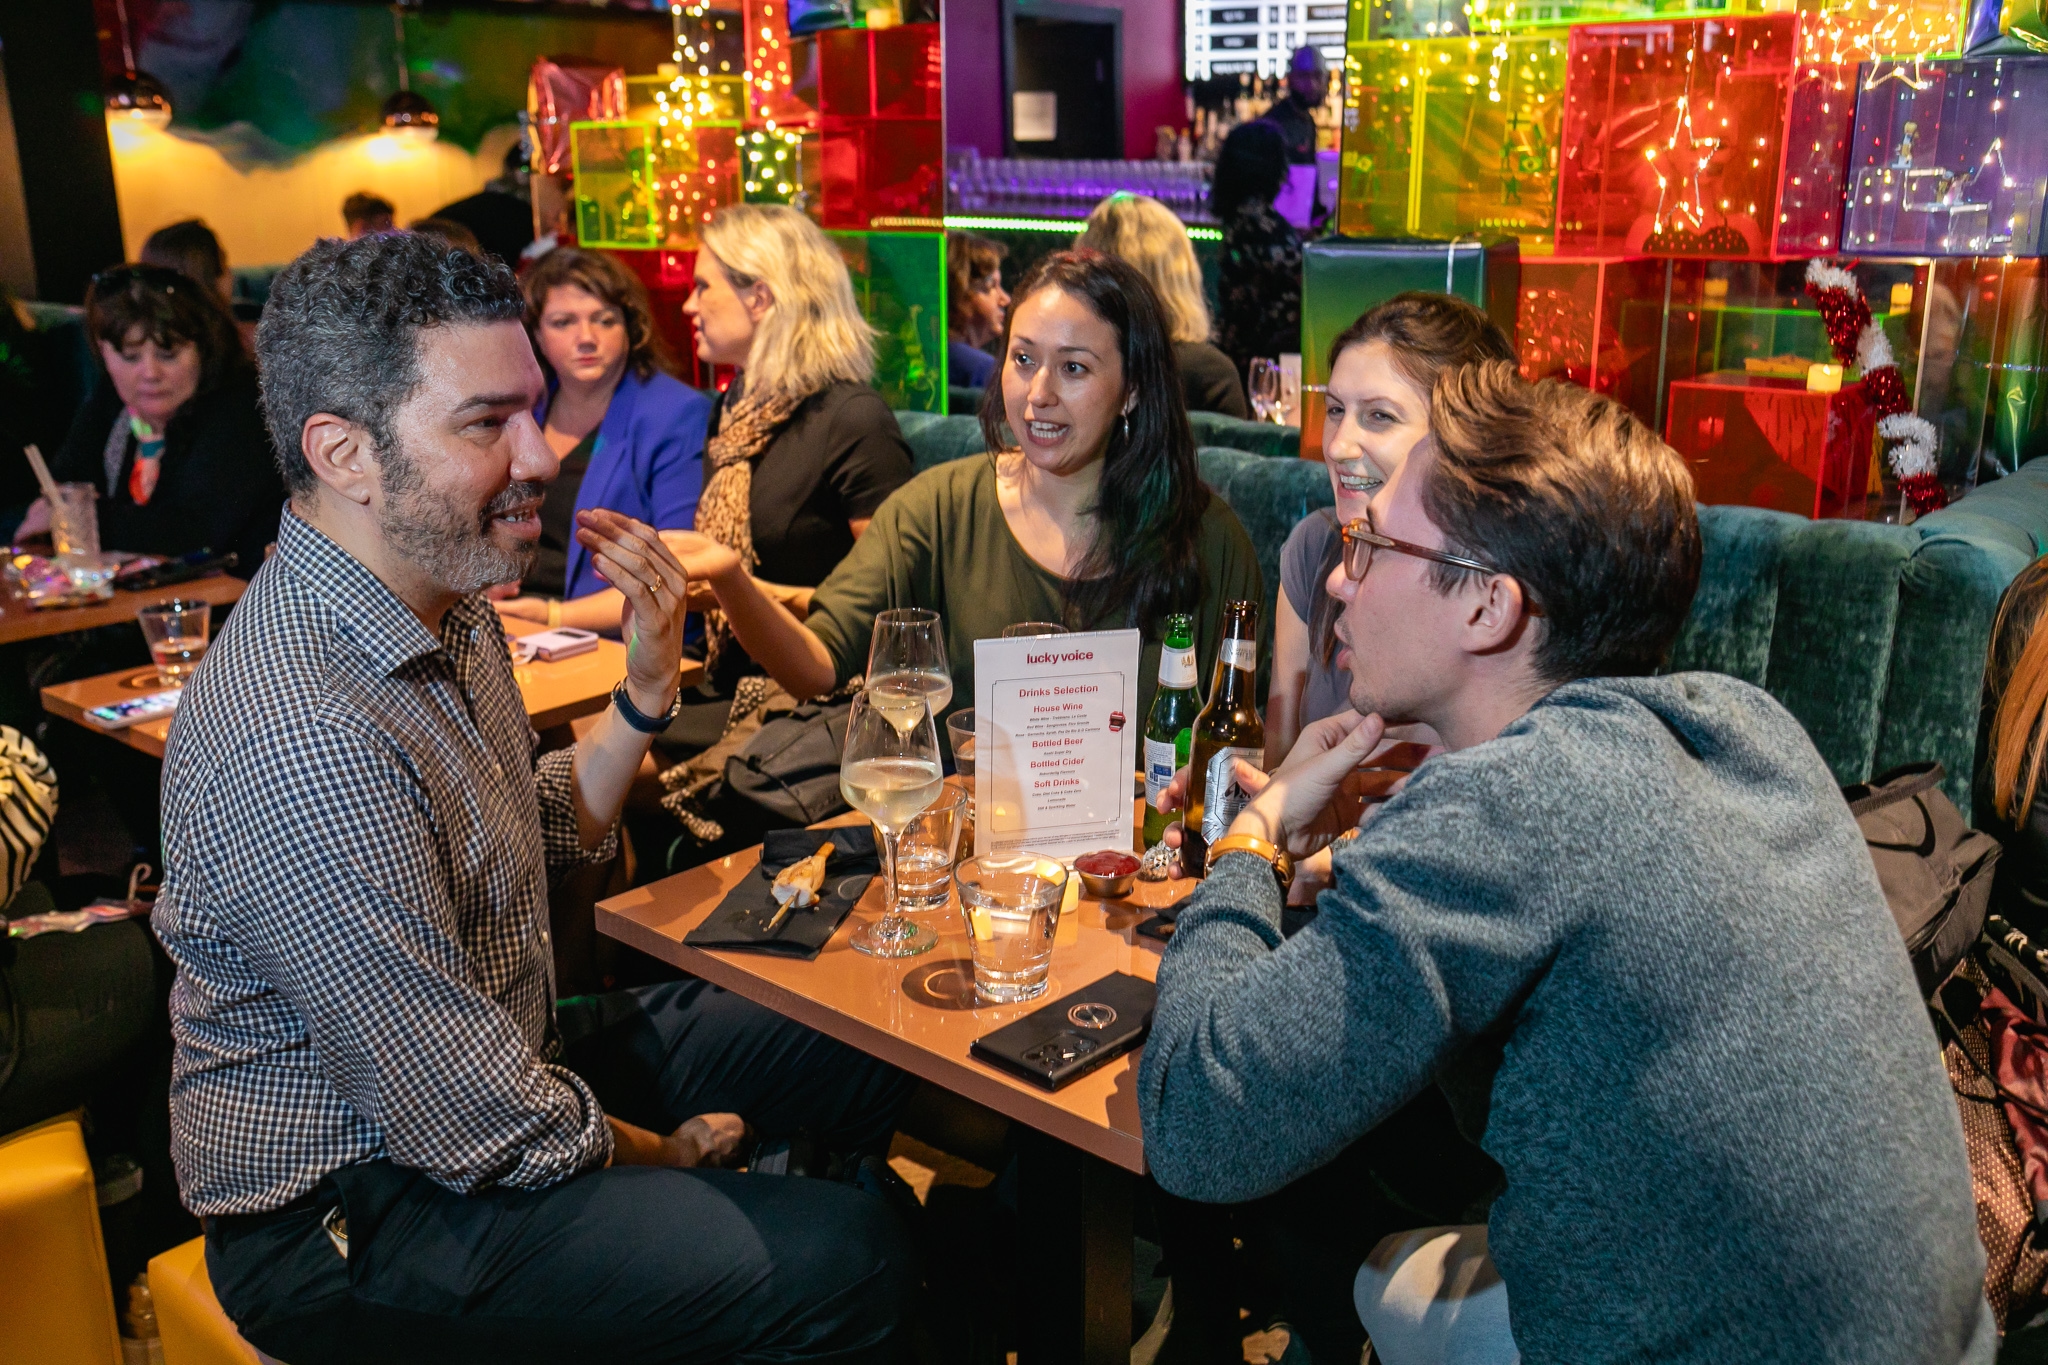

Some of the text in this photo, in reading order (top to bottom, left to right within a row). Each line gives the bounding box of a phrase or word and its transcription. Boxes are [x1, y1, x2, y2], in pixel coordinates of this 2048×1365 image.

[1026, 650, 1094, 664] lucky voice
[1019, 685, 1098, 698] Drinks Selection
[1032, 739, 1062, 748] Bottled
[1030, 759, 1060, 768] Bottled
[1053, 778, 1080, 786] Drinks
